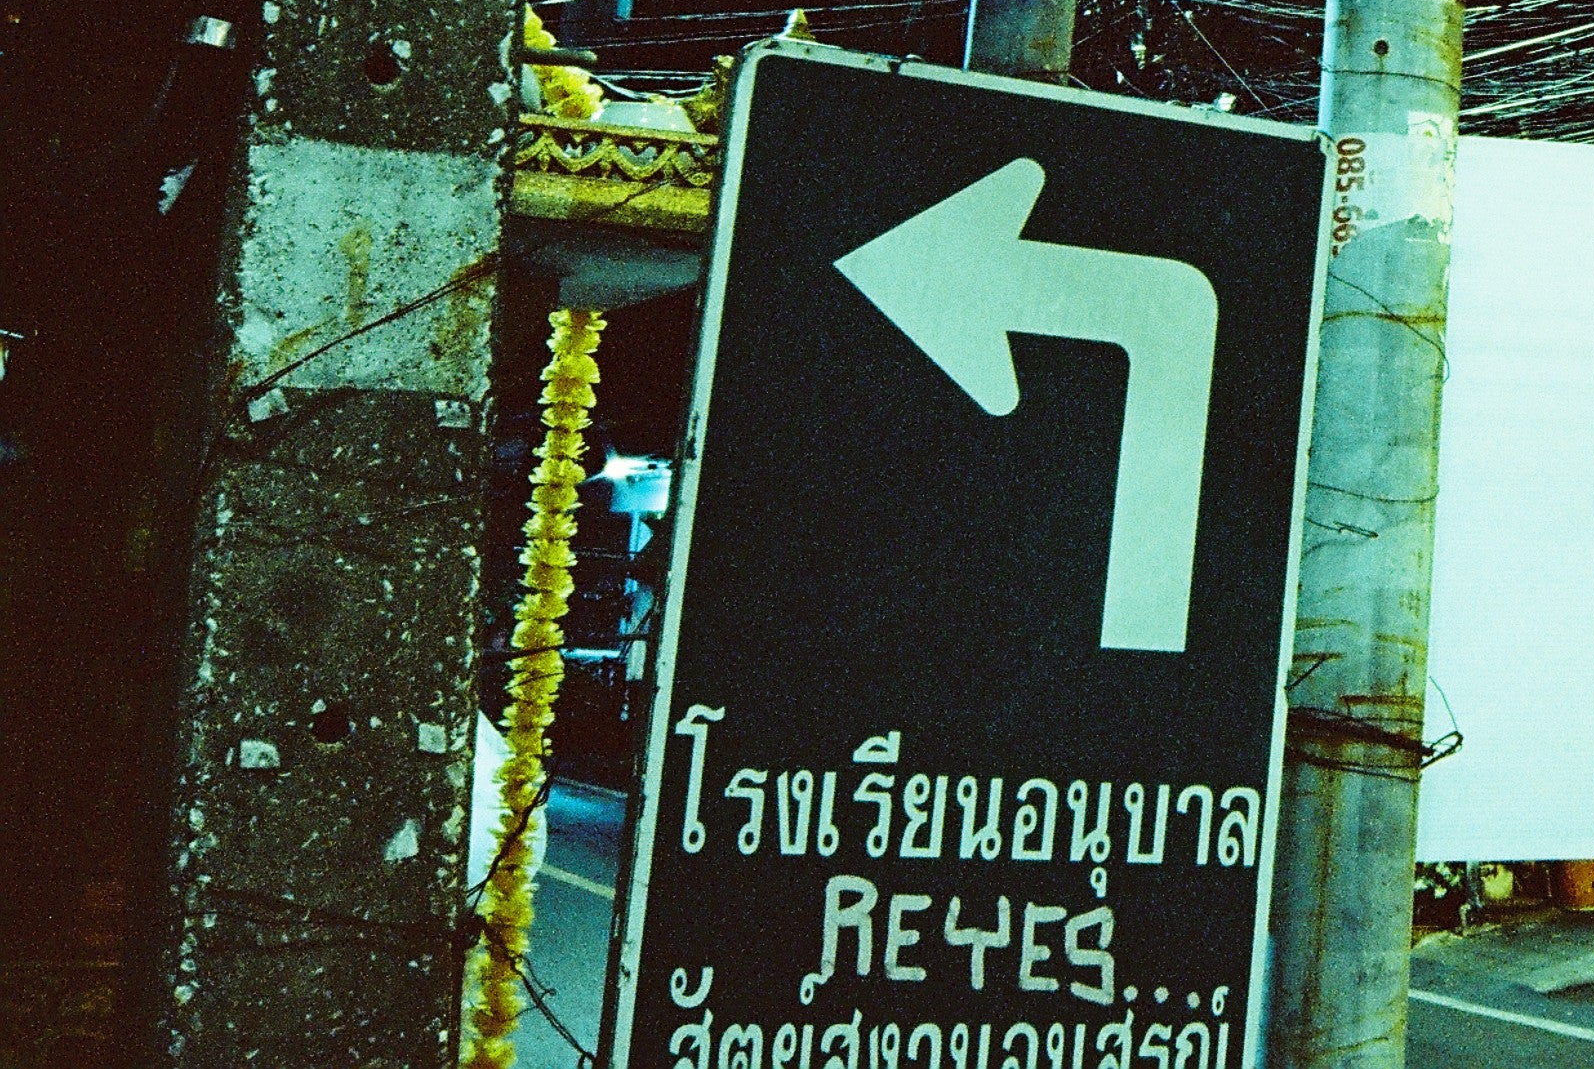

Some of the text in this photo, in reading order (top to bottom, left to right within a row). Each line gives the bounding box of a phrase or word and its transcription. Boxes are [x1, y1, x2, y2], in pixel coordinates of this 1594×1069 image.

[675, 704, 1263, 898] โรงเรียนอนุบาล
